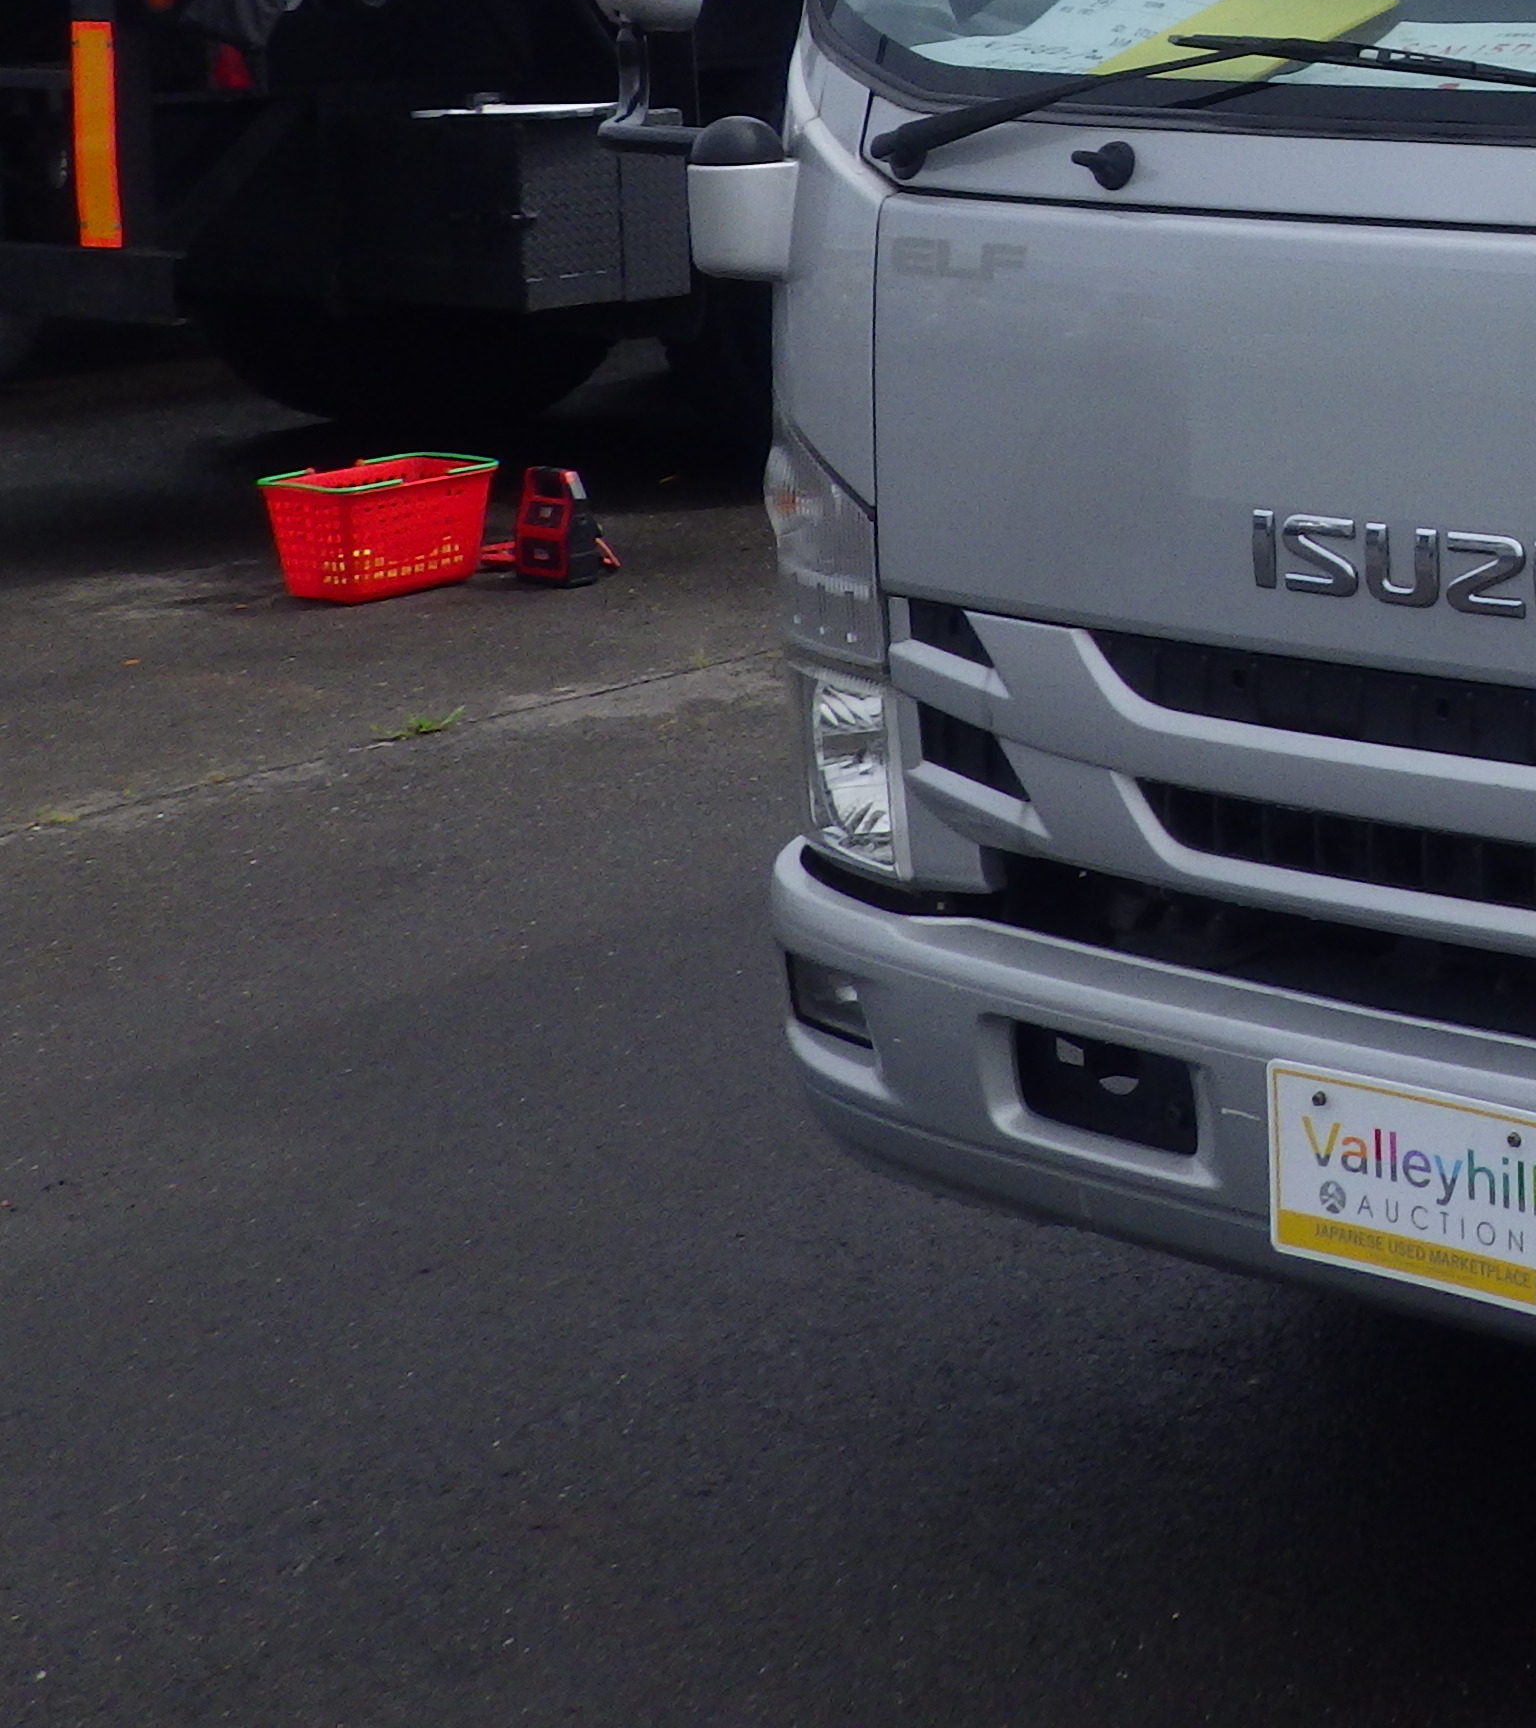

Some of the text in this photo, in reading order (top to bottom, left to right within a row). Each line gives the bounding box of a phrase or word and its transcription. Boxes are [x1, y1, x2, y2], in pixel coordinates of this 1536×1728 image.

[1314, 1222, 1532, 1288] JAPANESE USED MARKETPLACE
[1356, 1194, 1525, 1254] AUCTION
